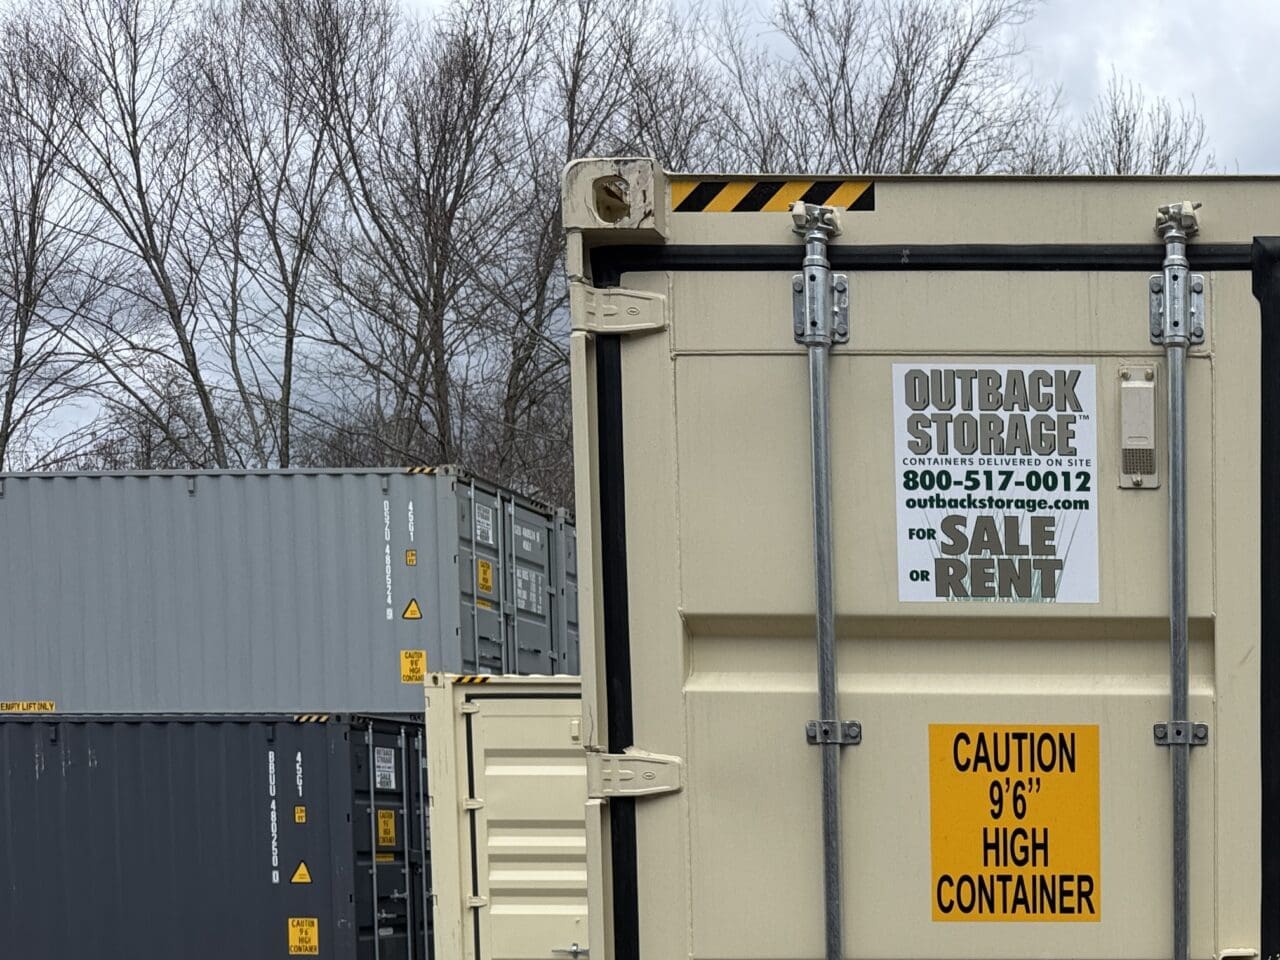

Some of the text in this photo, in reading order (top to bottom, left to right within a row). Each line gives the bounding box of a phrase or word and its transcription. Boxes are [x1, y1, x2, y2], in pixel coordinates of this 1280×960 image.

[905, 369, 1083, 412] OUTBACK
[907, 413, 1077, 456] STORAGE
[903, 457, 1092, 467] CONTAINERS DELIVERED ON SITE
[903, 470, 1091, 492] 800-517-0012
[905, 494, 1089, 512] outbackstorage.com
[908, 515, 1056, 556] FOR SALE
[909, 557, 1063, 597] OR RENT
[953, 732, 1076, 772] CAUTION
[983, 828, 1048, 867] HIGH
[937, 875, 1095, 914] CONTAINER
